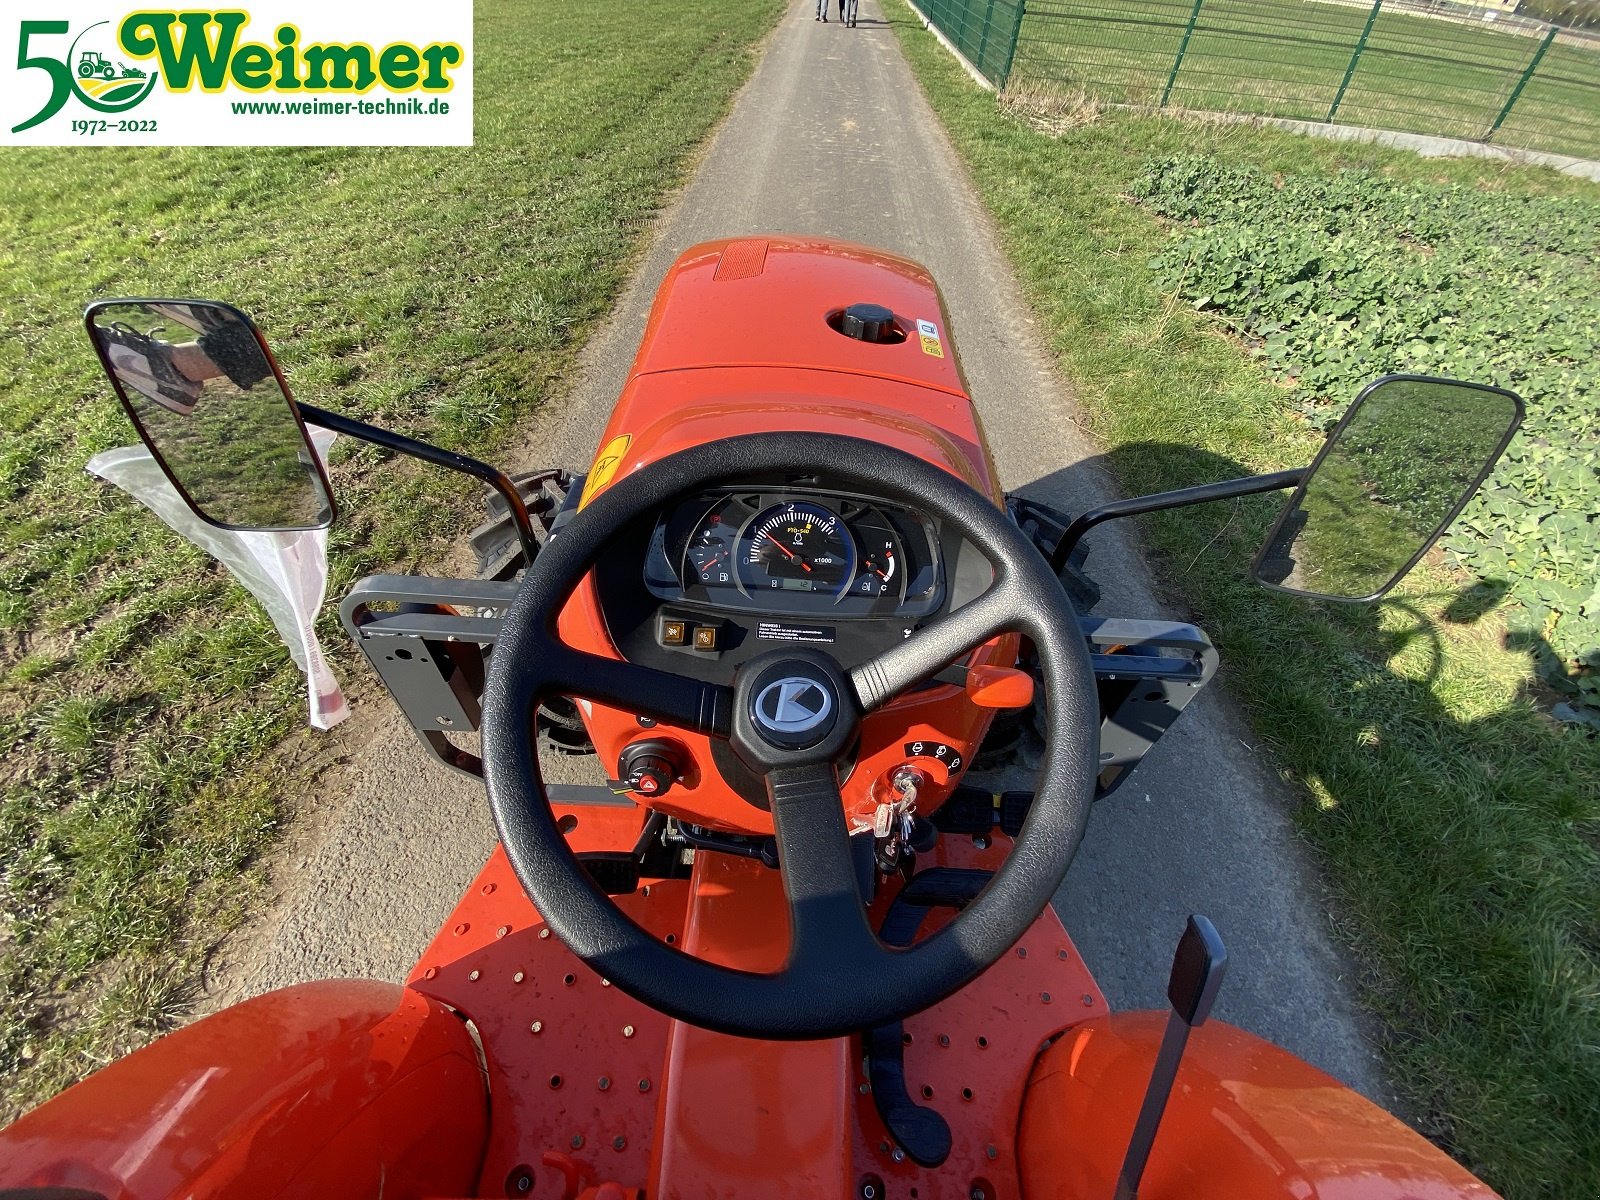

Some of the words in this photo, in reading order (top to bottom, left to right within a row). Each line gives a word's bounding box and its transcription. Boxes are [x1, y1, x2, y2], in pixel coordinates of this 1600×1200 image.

[787, 503, 795, 512] 2
[828, 516, 836, 525] 3
[752, 525, 757, 533] 1
[885, 541, 892, 549] H
[742, 557, 750, 565] 0
